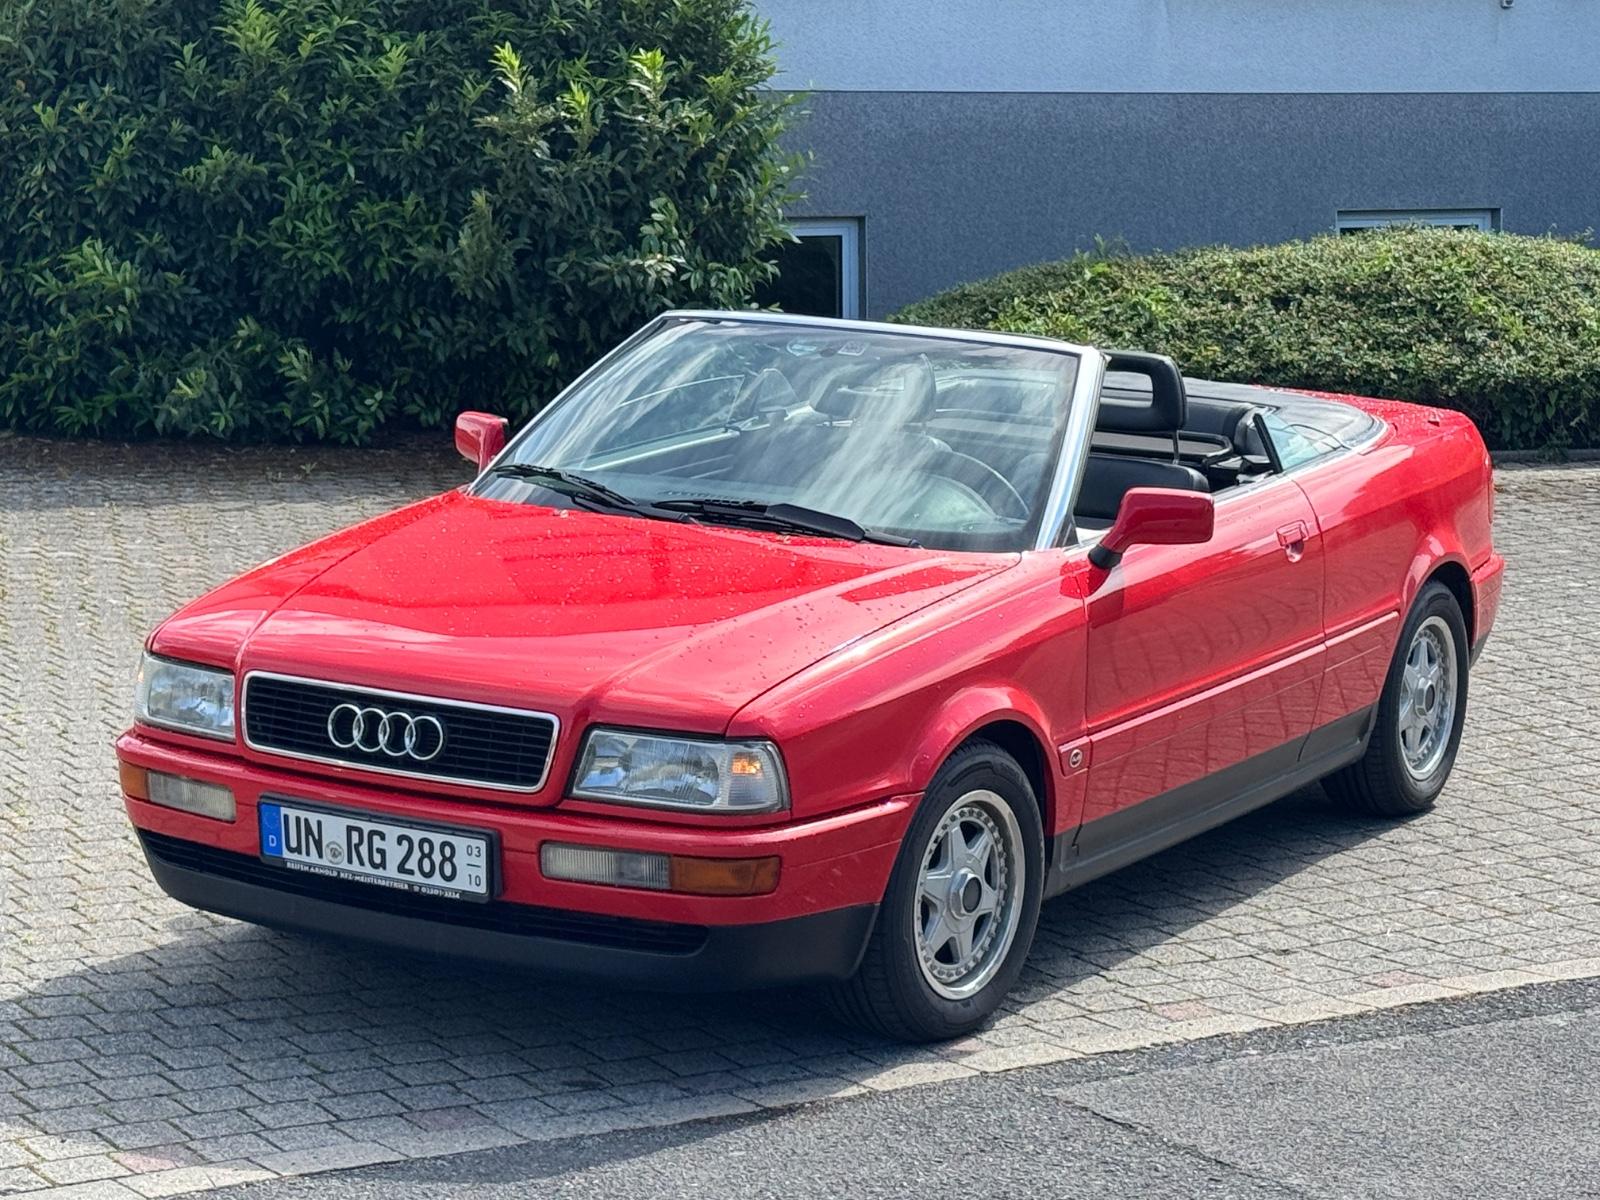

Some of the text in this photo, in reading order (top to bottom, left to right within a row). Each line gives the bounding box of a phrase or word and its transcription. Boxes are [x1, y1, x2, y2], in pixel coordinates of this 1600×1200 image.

[269, 835, 277, 847] D
[283, 814, 457, 882] UN RG 288
[466, 844, 482, 858] 03
[309, 866, 338, 878] ARNOLD
[468, 873, 481, 887] 10
